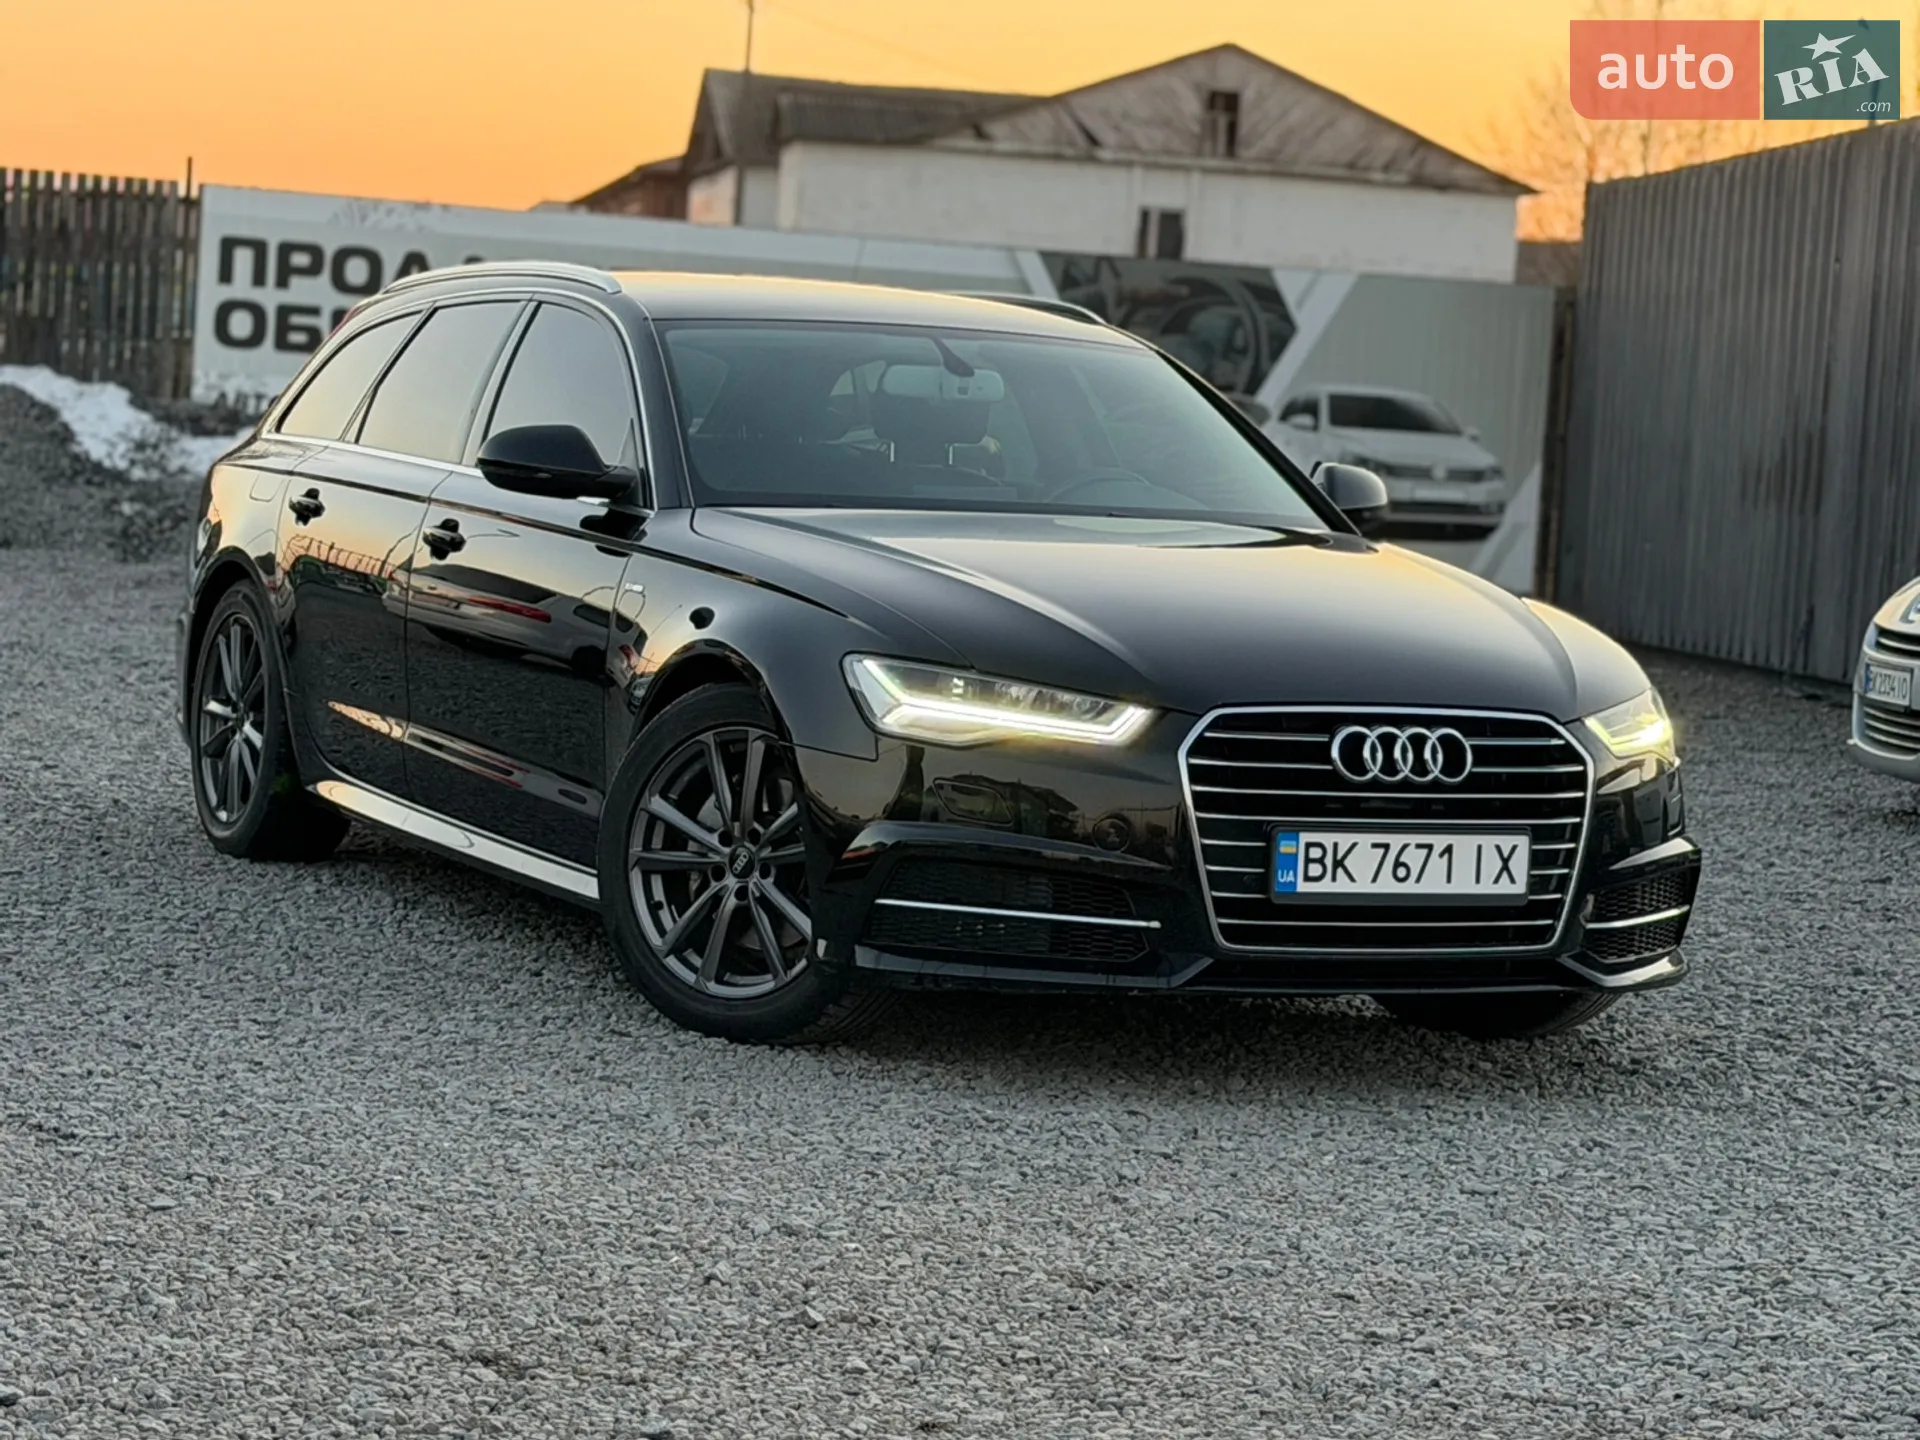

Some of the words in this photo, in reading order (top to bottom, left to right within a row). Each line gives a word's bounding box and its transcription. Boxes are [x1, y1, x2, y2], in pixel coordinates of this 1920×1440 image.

[217, 236, 484, 297] ПРО
[213, 298, 349, 355] ОБ
[1278, 870, 1295, 883] UA
[1302, 841, 1359, 883] BK
[1370, 843, 1454, 884] 7671
[1474, 844, 1519, 885] IX
